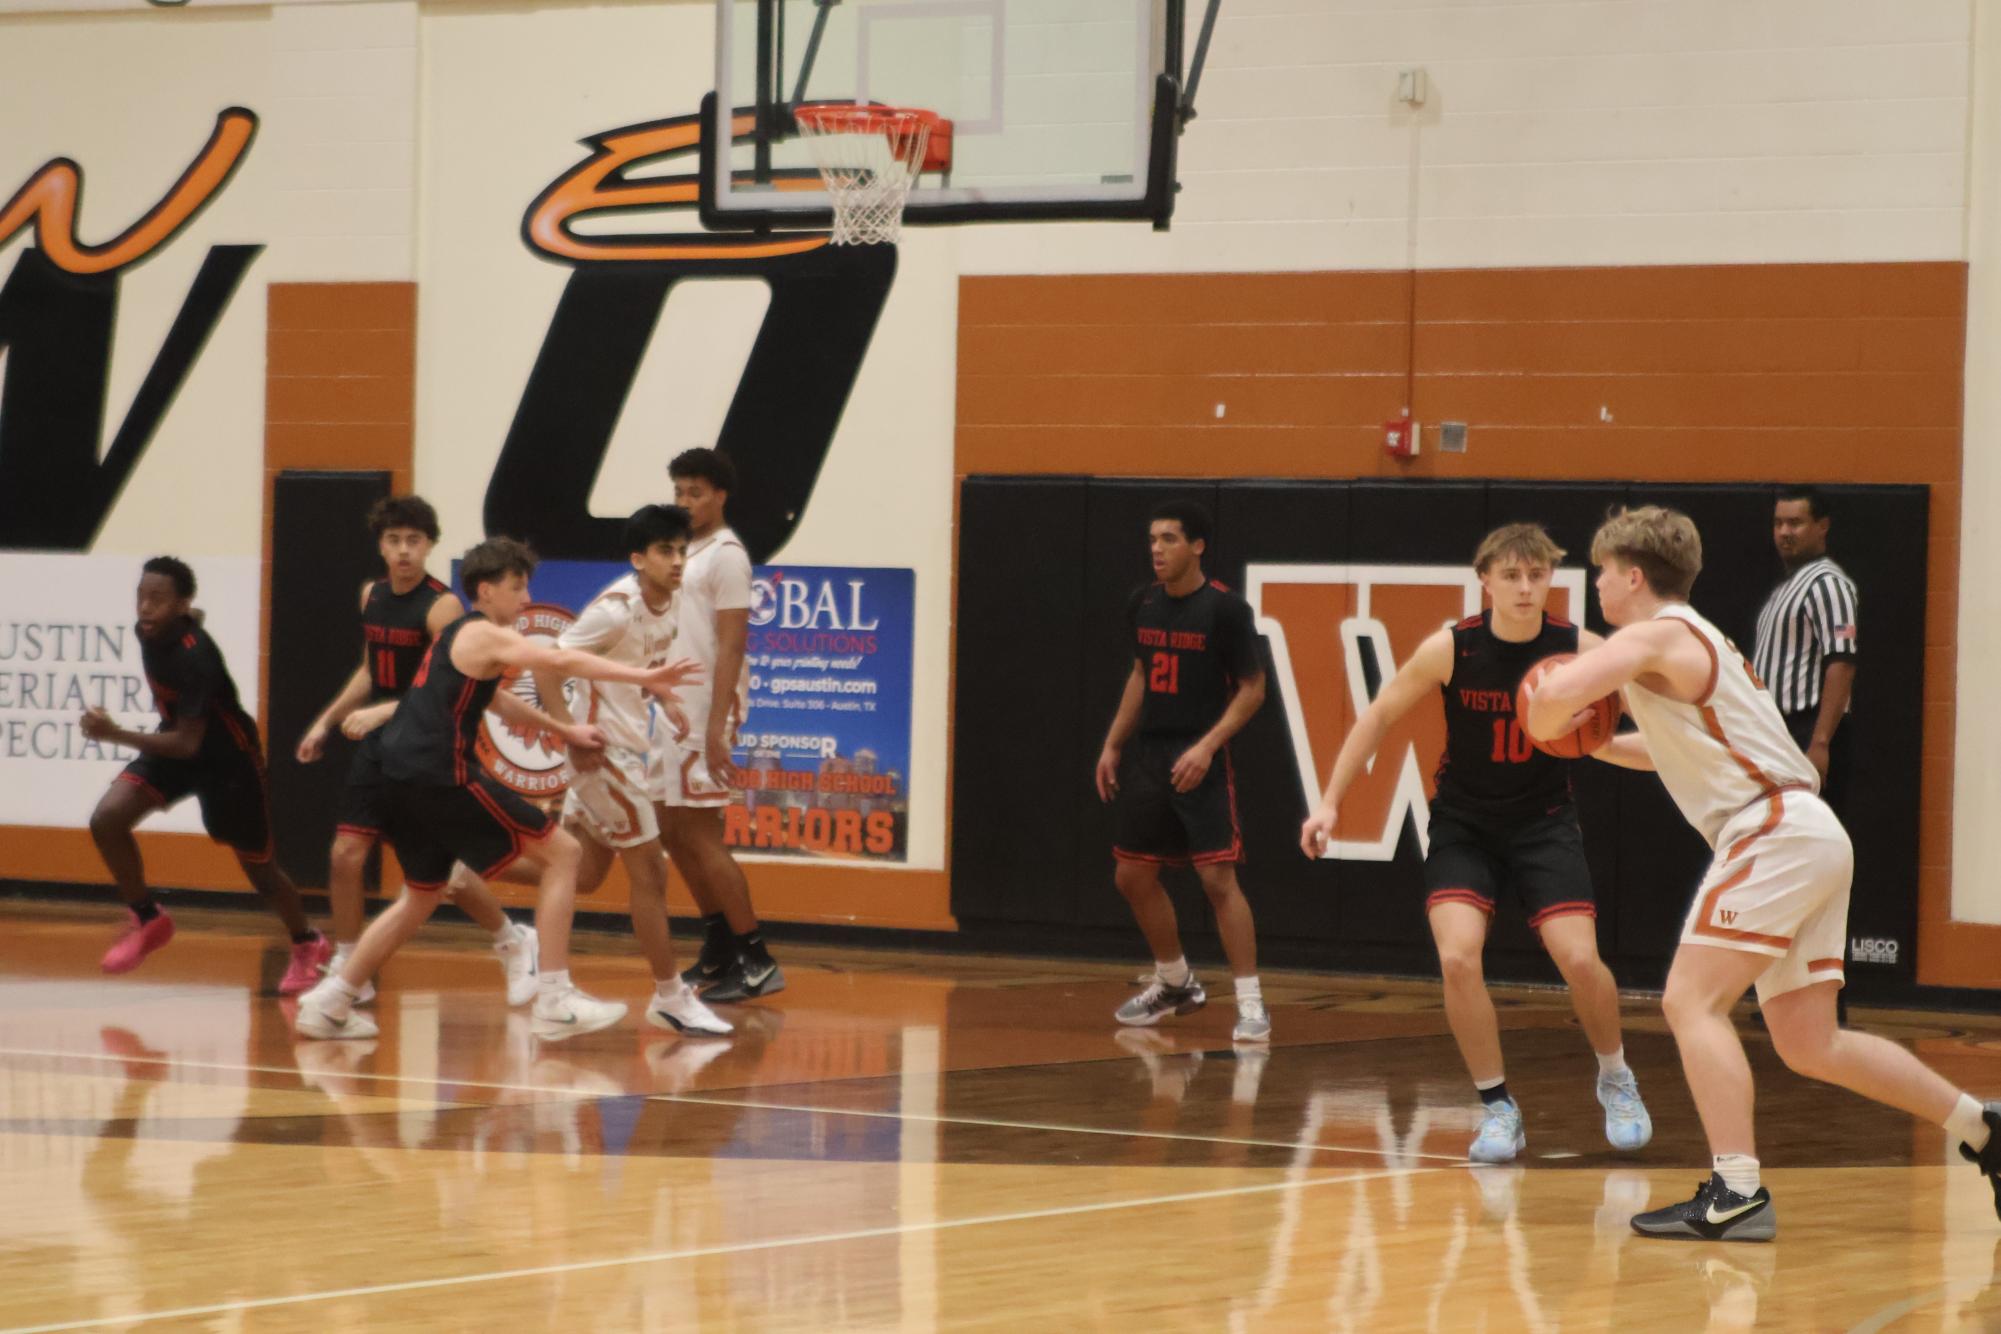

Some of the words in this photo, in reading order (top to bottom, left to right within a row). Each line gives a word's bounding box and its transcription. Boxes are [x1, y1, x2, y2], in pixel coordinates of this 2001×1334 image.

[765, 633, 878, 654] SOLUTIONS
[1150, 652, 1178, 694] 21
[1460, 690, 1512, 712] VISTA
[761, 734, 837, 759] SPONSOR
[1491, 719, 1533, 764] 10
[765, 771, 815, 791] HIGH
[819, 773, 896, 796] SCHOOL
[1720, 909, 1738, 925] W
[1852, 938, 1899, 954] LISCO
